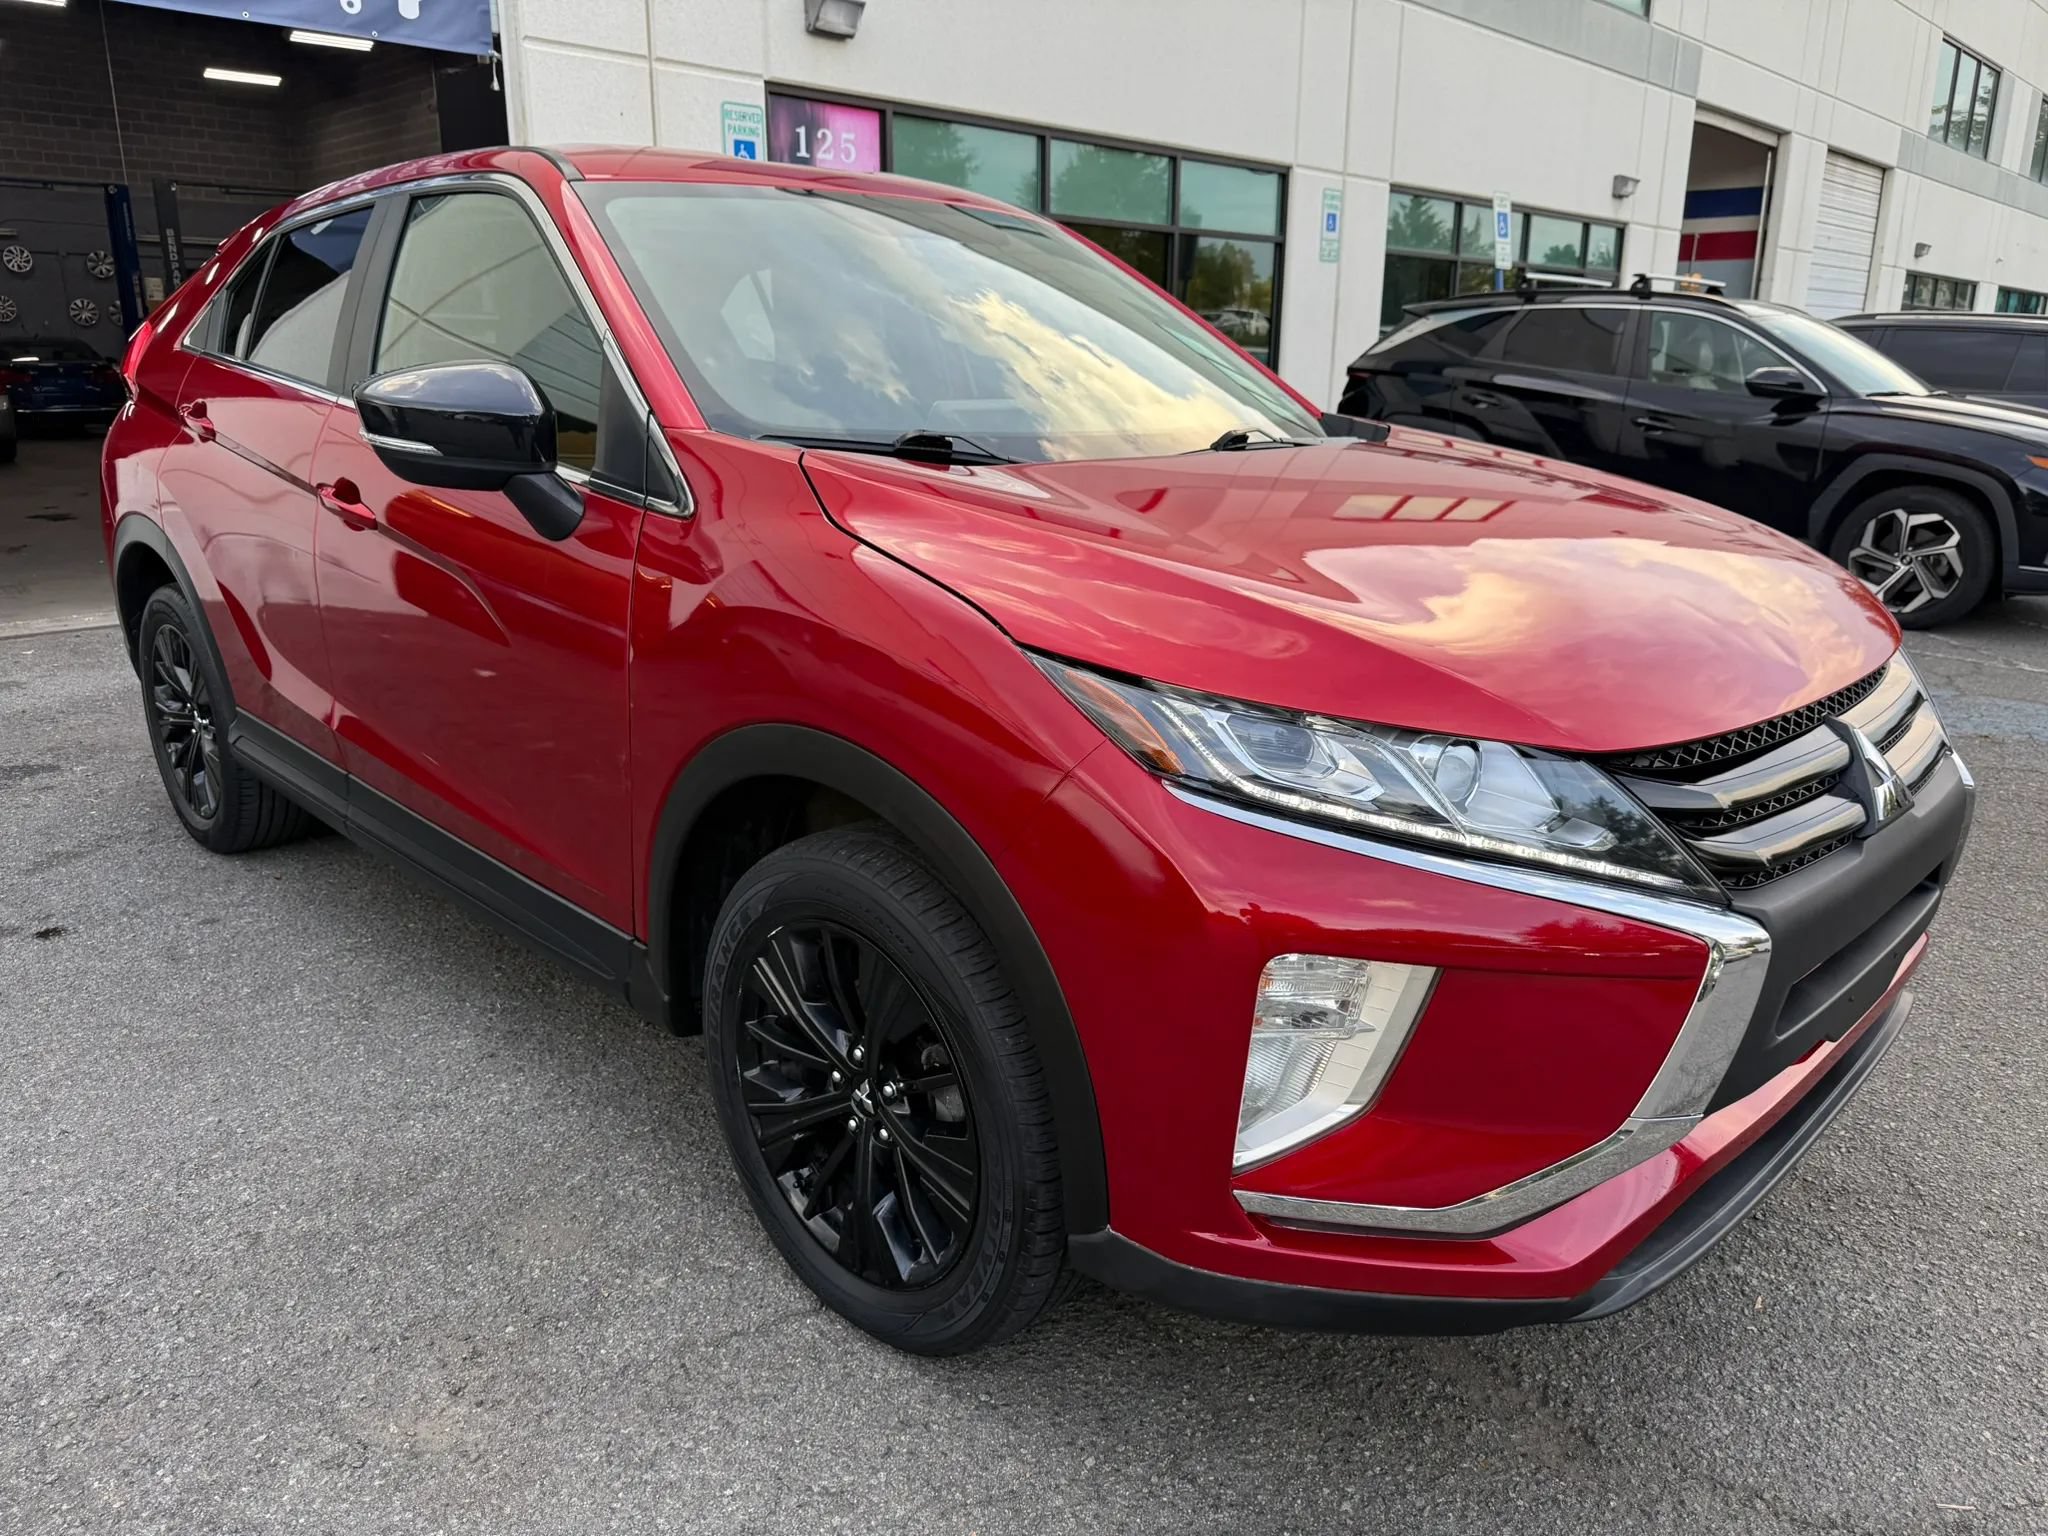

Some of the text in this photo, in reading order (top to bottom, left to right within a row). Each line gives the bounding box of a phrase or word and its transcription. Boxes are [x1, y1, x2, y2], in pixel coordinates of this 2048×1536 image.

[724, 109, 761, 124] RESERVED
[727, 122, 761, 138] PARKING
[795, 125, 857, 164] 125
